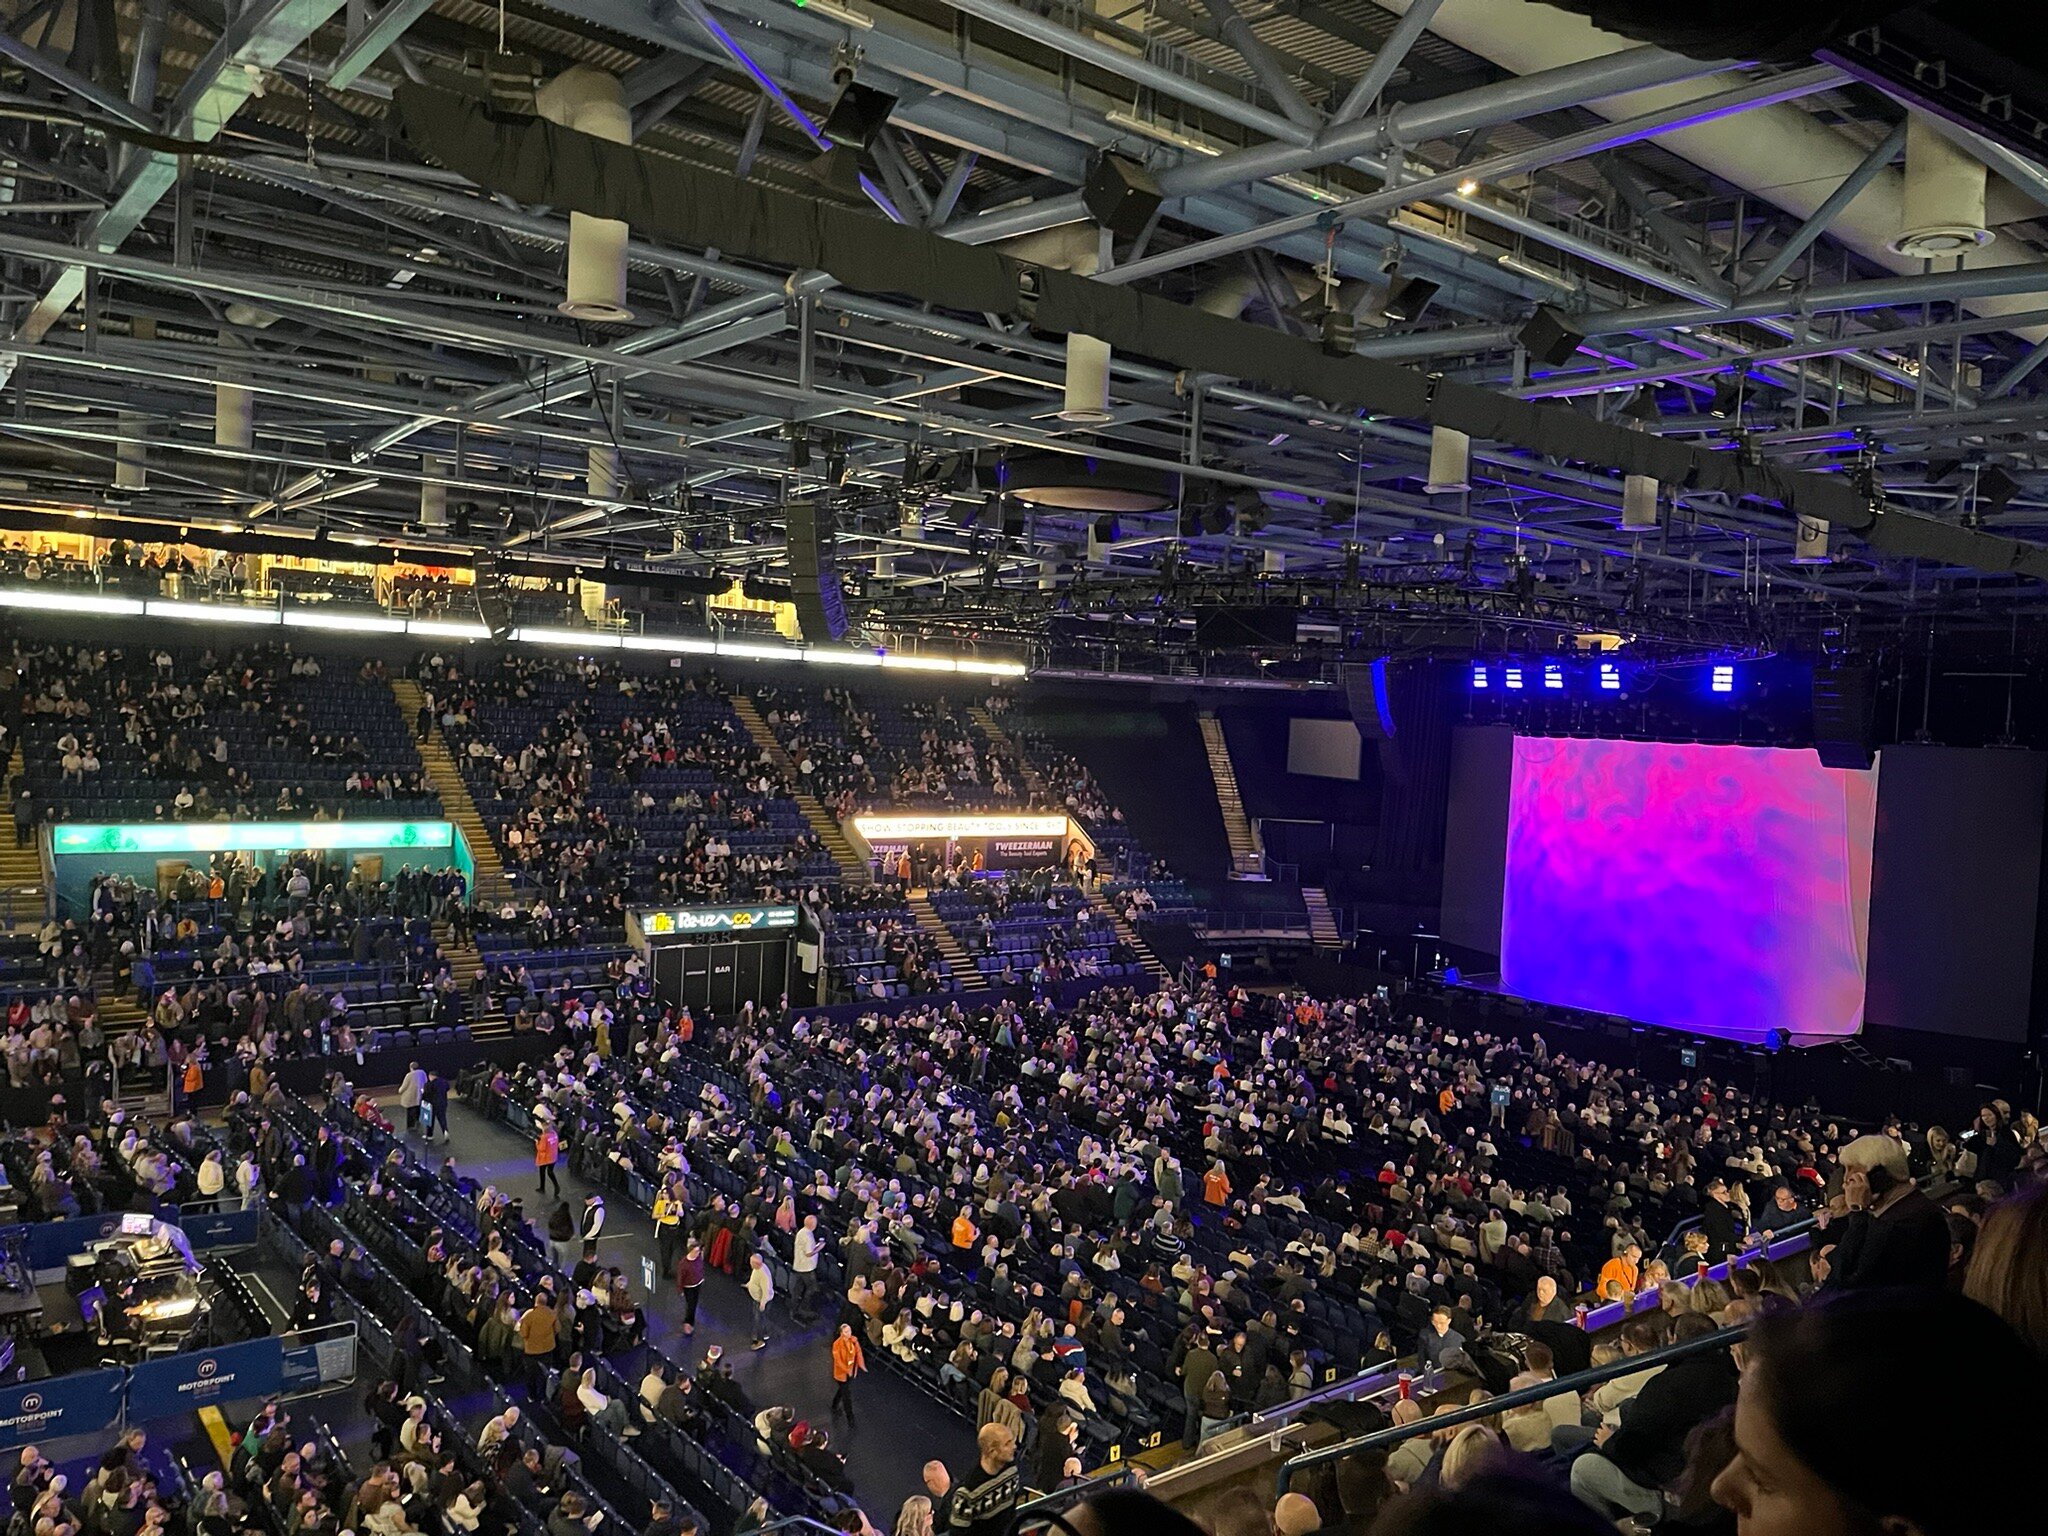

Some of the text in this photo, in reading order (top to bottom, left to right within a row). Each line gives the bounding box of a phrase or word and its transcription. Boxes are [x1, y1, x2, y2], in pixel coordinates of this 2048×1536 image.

[626, 563, 686, 576] FIRE & SECURITY
[995, 841, 1053, 851] TWEEZERMAN
[715, 965, 730, 974] BAR
[178, 1373, 236, 1392] MOTORPOINT
[0, 1408, 63, 1428] MOTORPOINT
